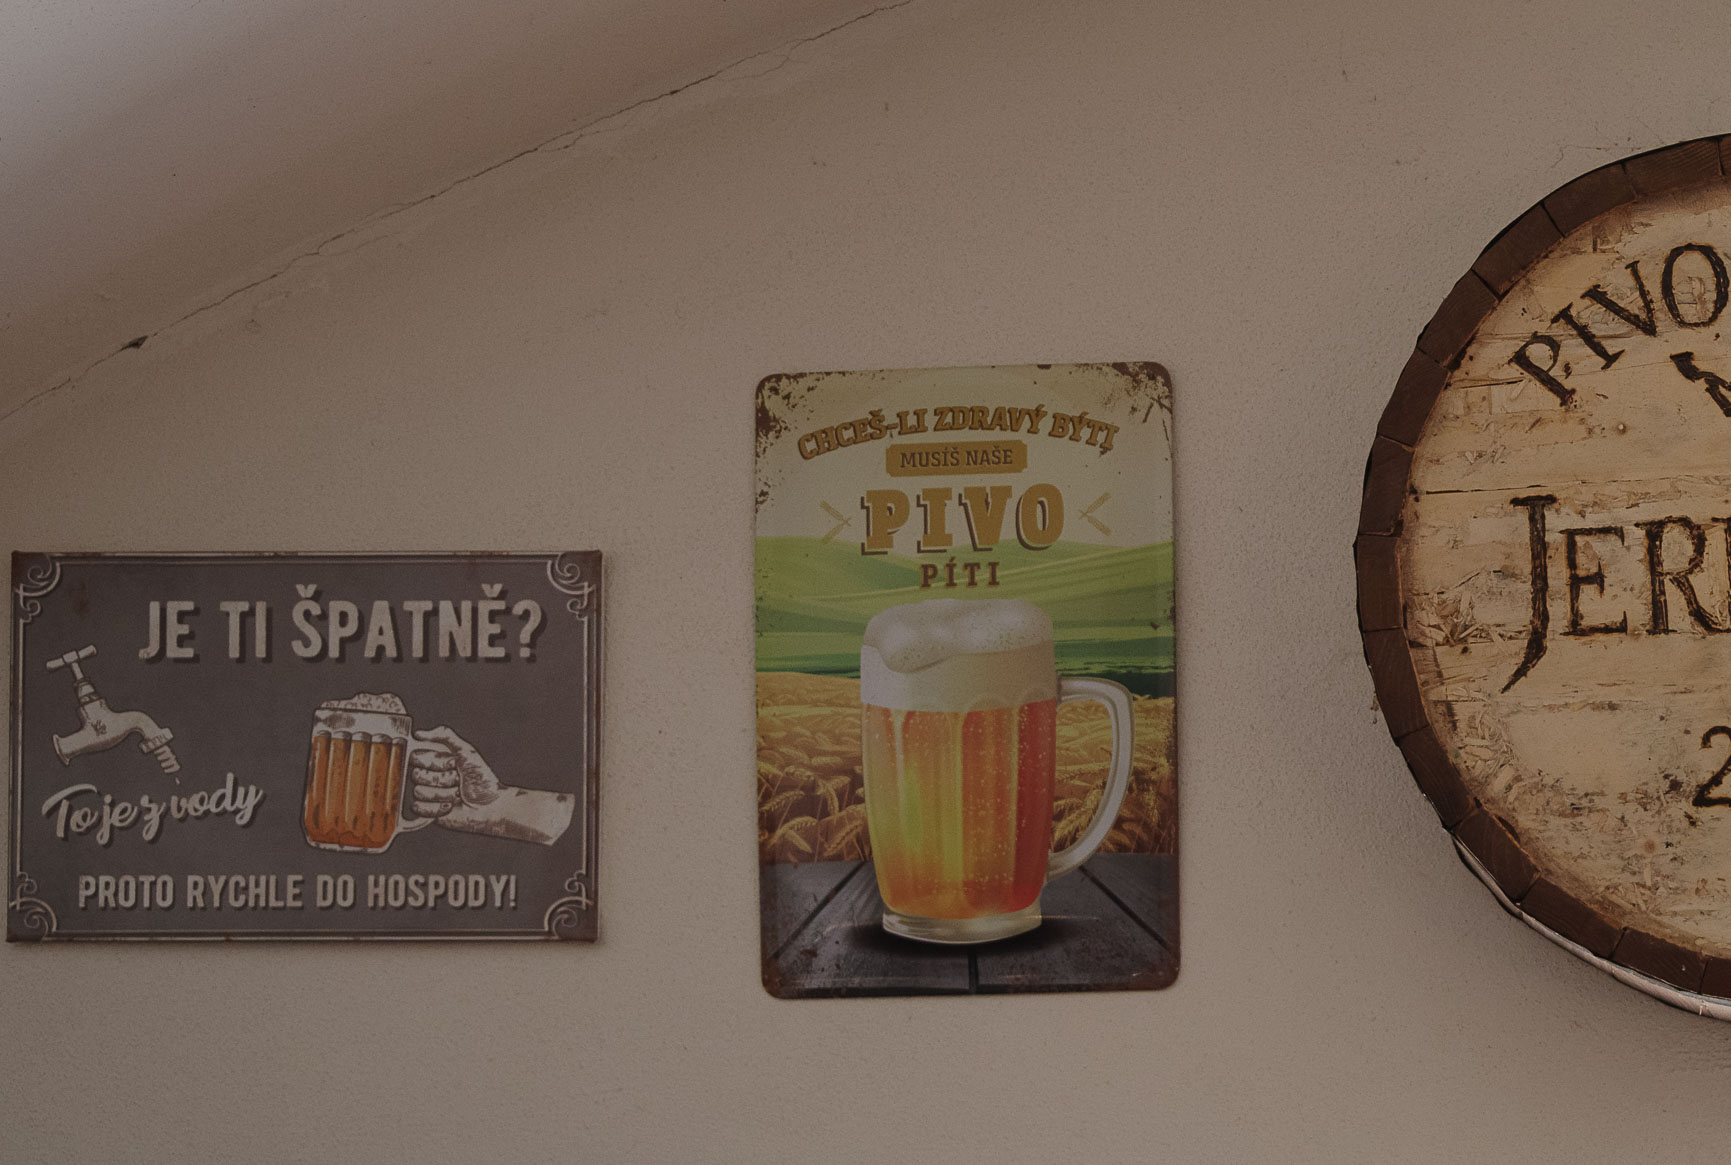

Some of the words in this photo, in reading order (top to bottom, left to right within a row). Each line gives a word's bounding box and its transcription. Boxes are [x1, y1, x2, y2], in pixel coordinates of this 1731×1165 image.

[798, 408, 928, 460] CHCEŠ-LI
[934, 404, 1047, 433] ZDRAVÝ
[900, 447, 960, 468] MUSÍŠ
[966, 445, 1013, 466] NAŠE
[861, 483, 1064, 555] PIVO
[920, 557, 1000, 588] PÍTI
[139, 600, 195, 659] JE
[220, 600, 267, 659] TI
[291, 583, 544, 660] ŠPATNĚ?
[41, 783, 98, 838] To
[96, 794, 138, 845] je
[140, 795, 166, 841] z
[170, 772, 263, 825] vody
[79, 874, 174, 908] PROTO
[187, 874, 303, 908] RYCHLE
[316, 874, 356, 908] DO
[368, 874, 517, 908] HOSPODY!
